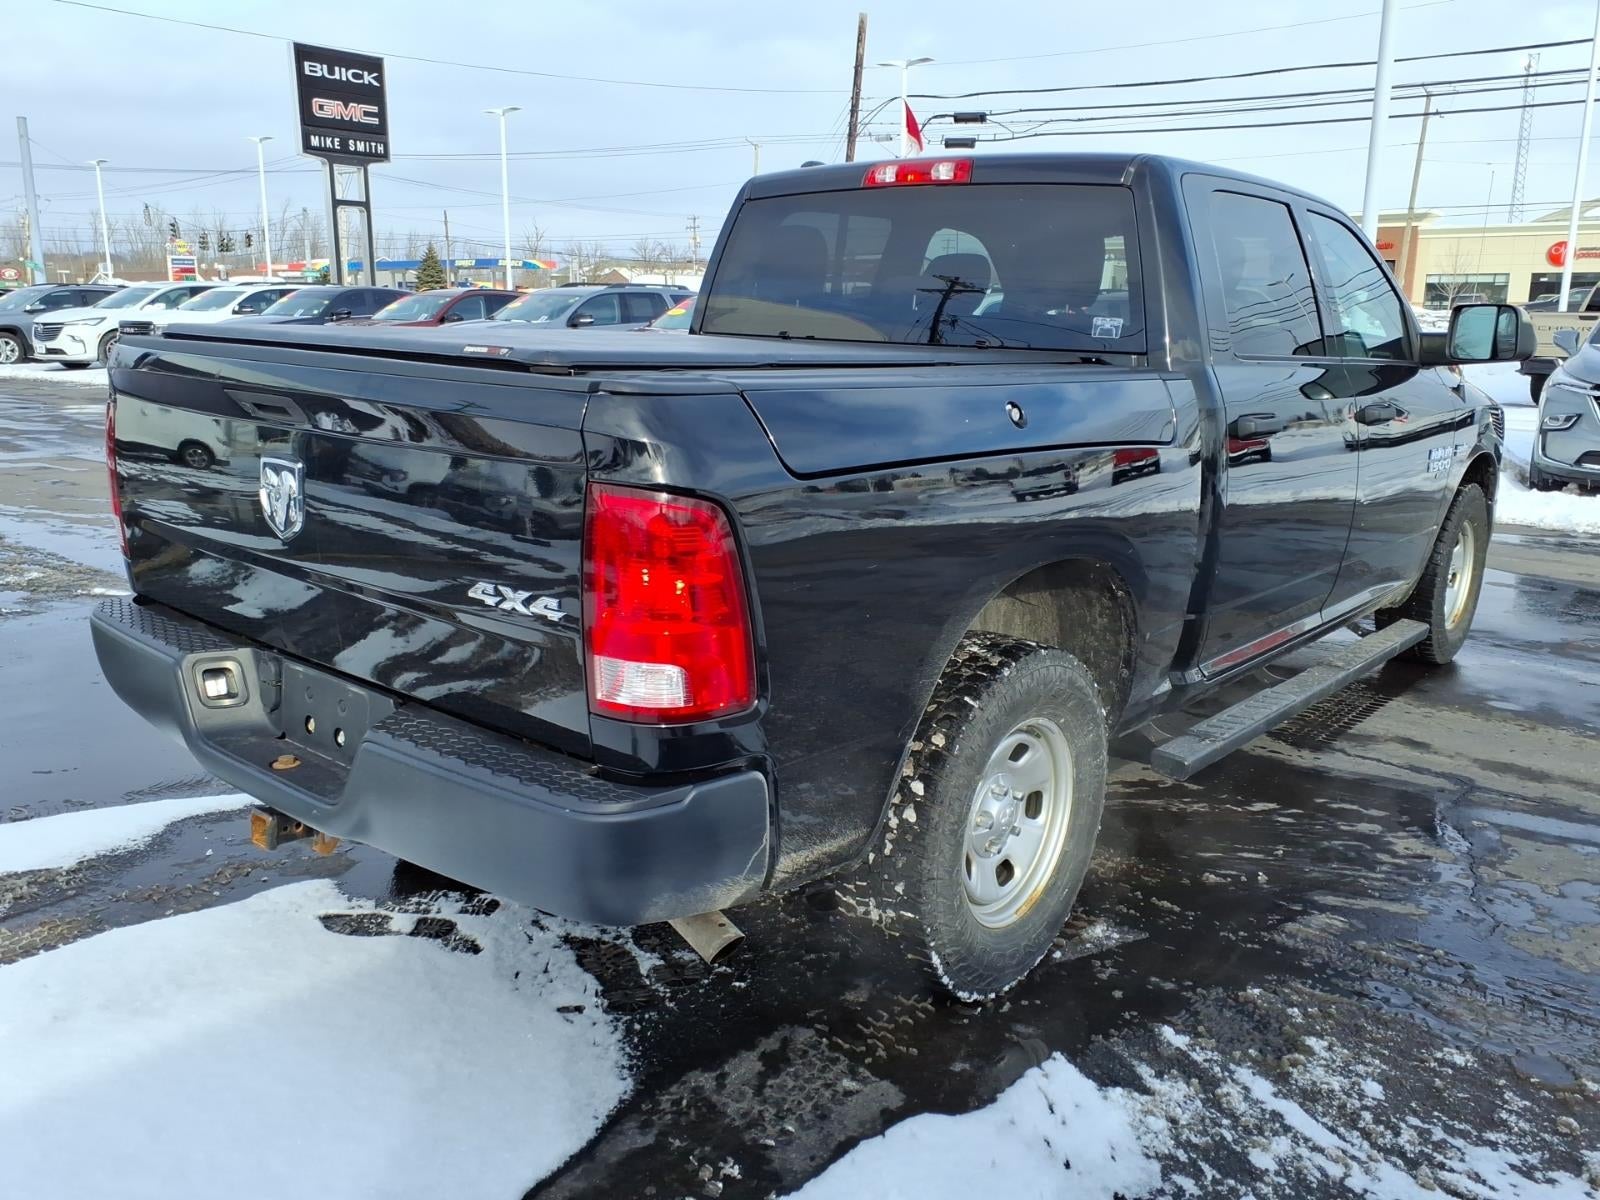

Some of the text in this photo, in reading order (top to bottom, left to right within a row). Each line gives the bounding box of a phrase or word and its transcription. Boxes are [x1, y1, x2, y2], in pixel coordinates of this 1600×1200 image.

[304, 61, 380, 87] BUICK
[312, 97, 379, 125] GMC
[310, 135, 384, 154] MIKE SMITH
[1427, 458, 1451, 472] 1500
